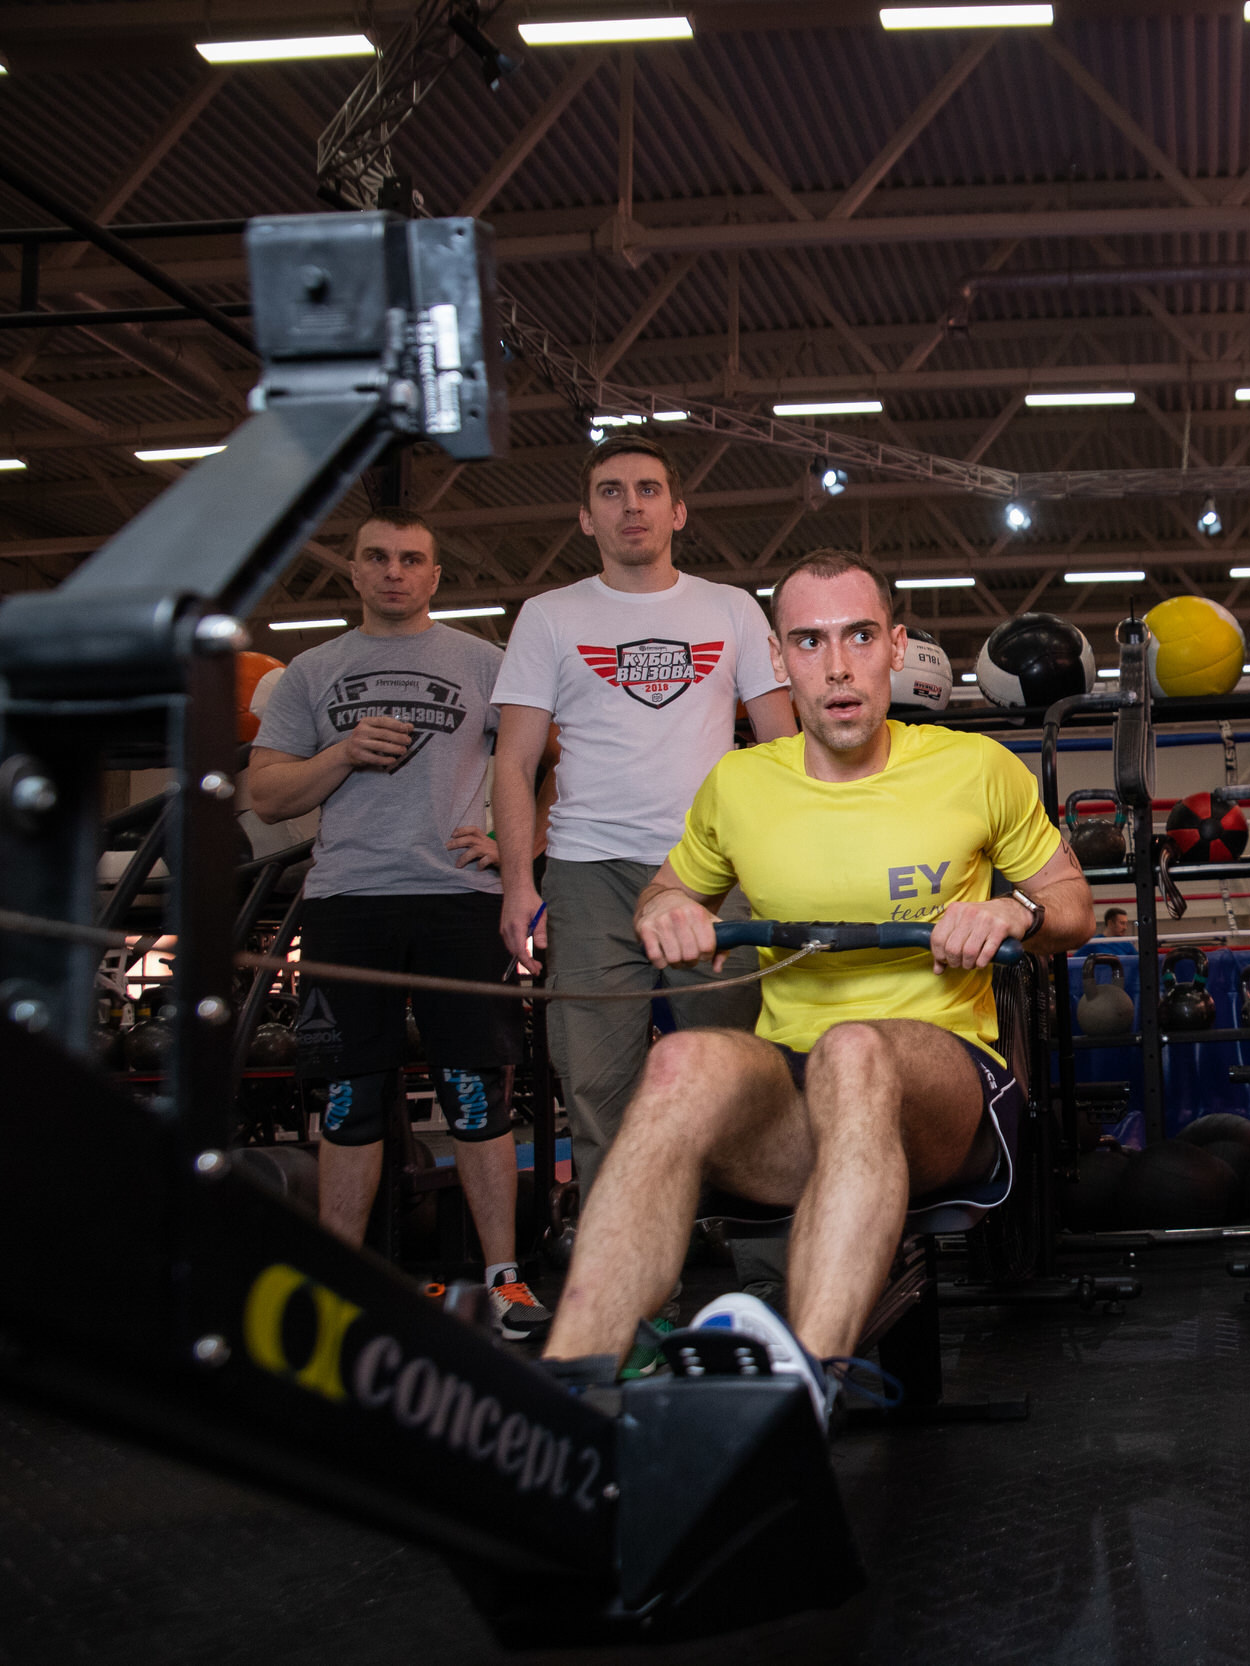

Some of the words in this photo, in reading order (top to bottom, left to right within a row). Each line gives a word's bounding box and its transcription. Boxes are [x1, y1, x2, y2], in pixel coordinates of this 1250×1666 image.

[622, 651, 686, 667] КУБОК
[616, 665, 695, 681] ВЫЗОВА
[645, 684, 668, 692] 2018
[392, 706, 455, 729] ВЫЗОВА
[888, 860, 951, 901] EY
[354, 1335, 573, 1496] concept
